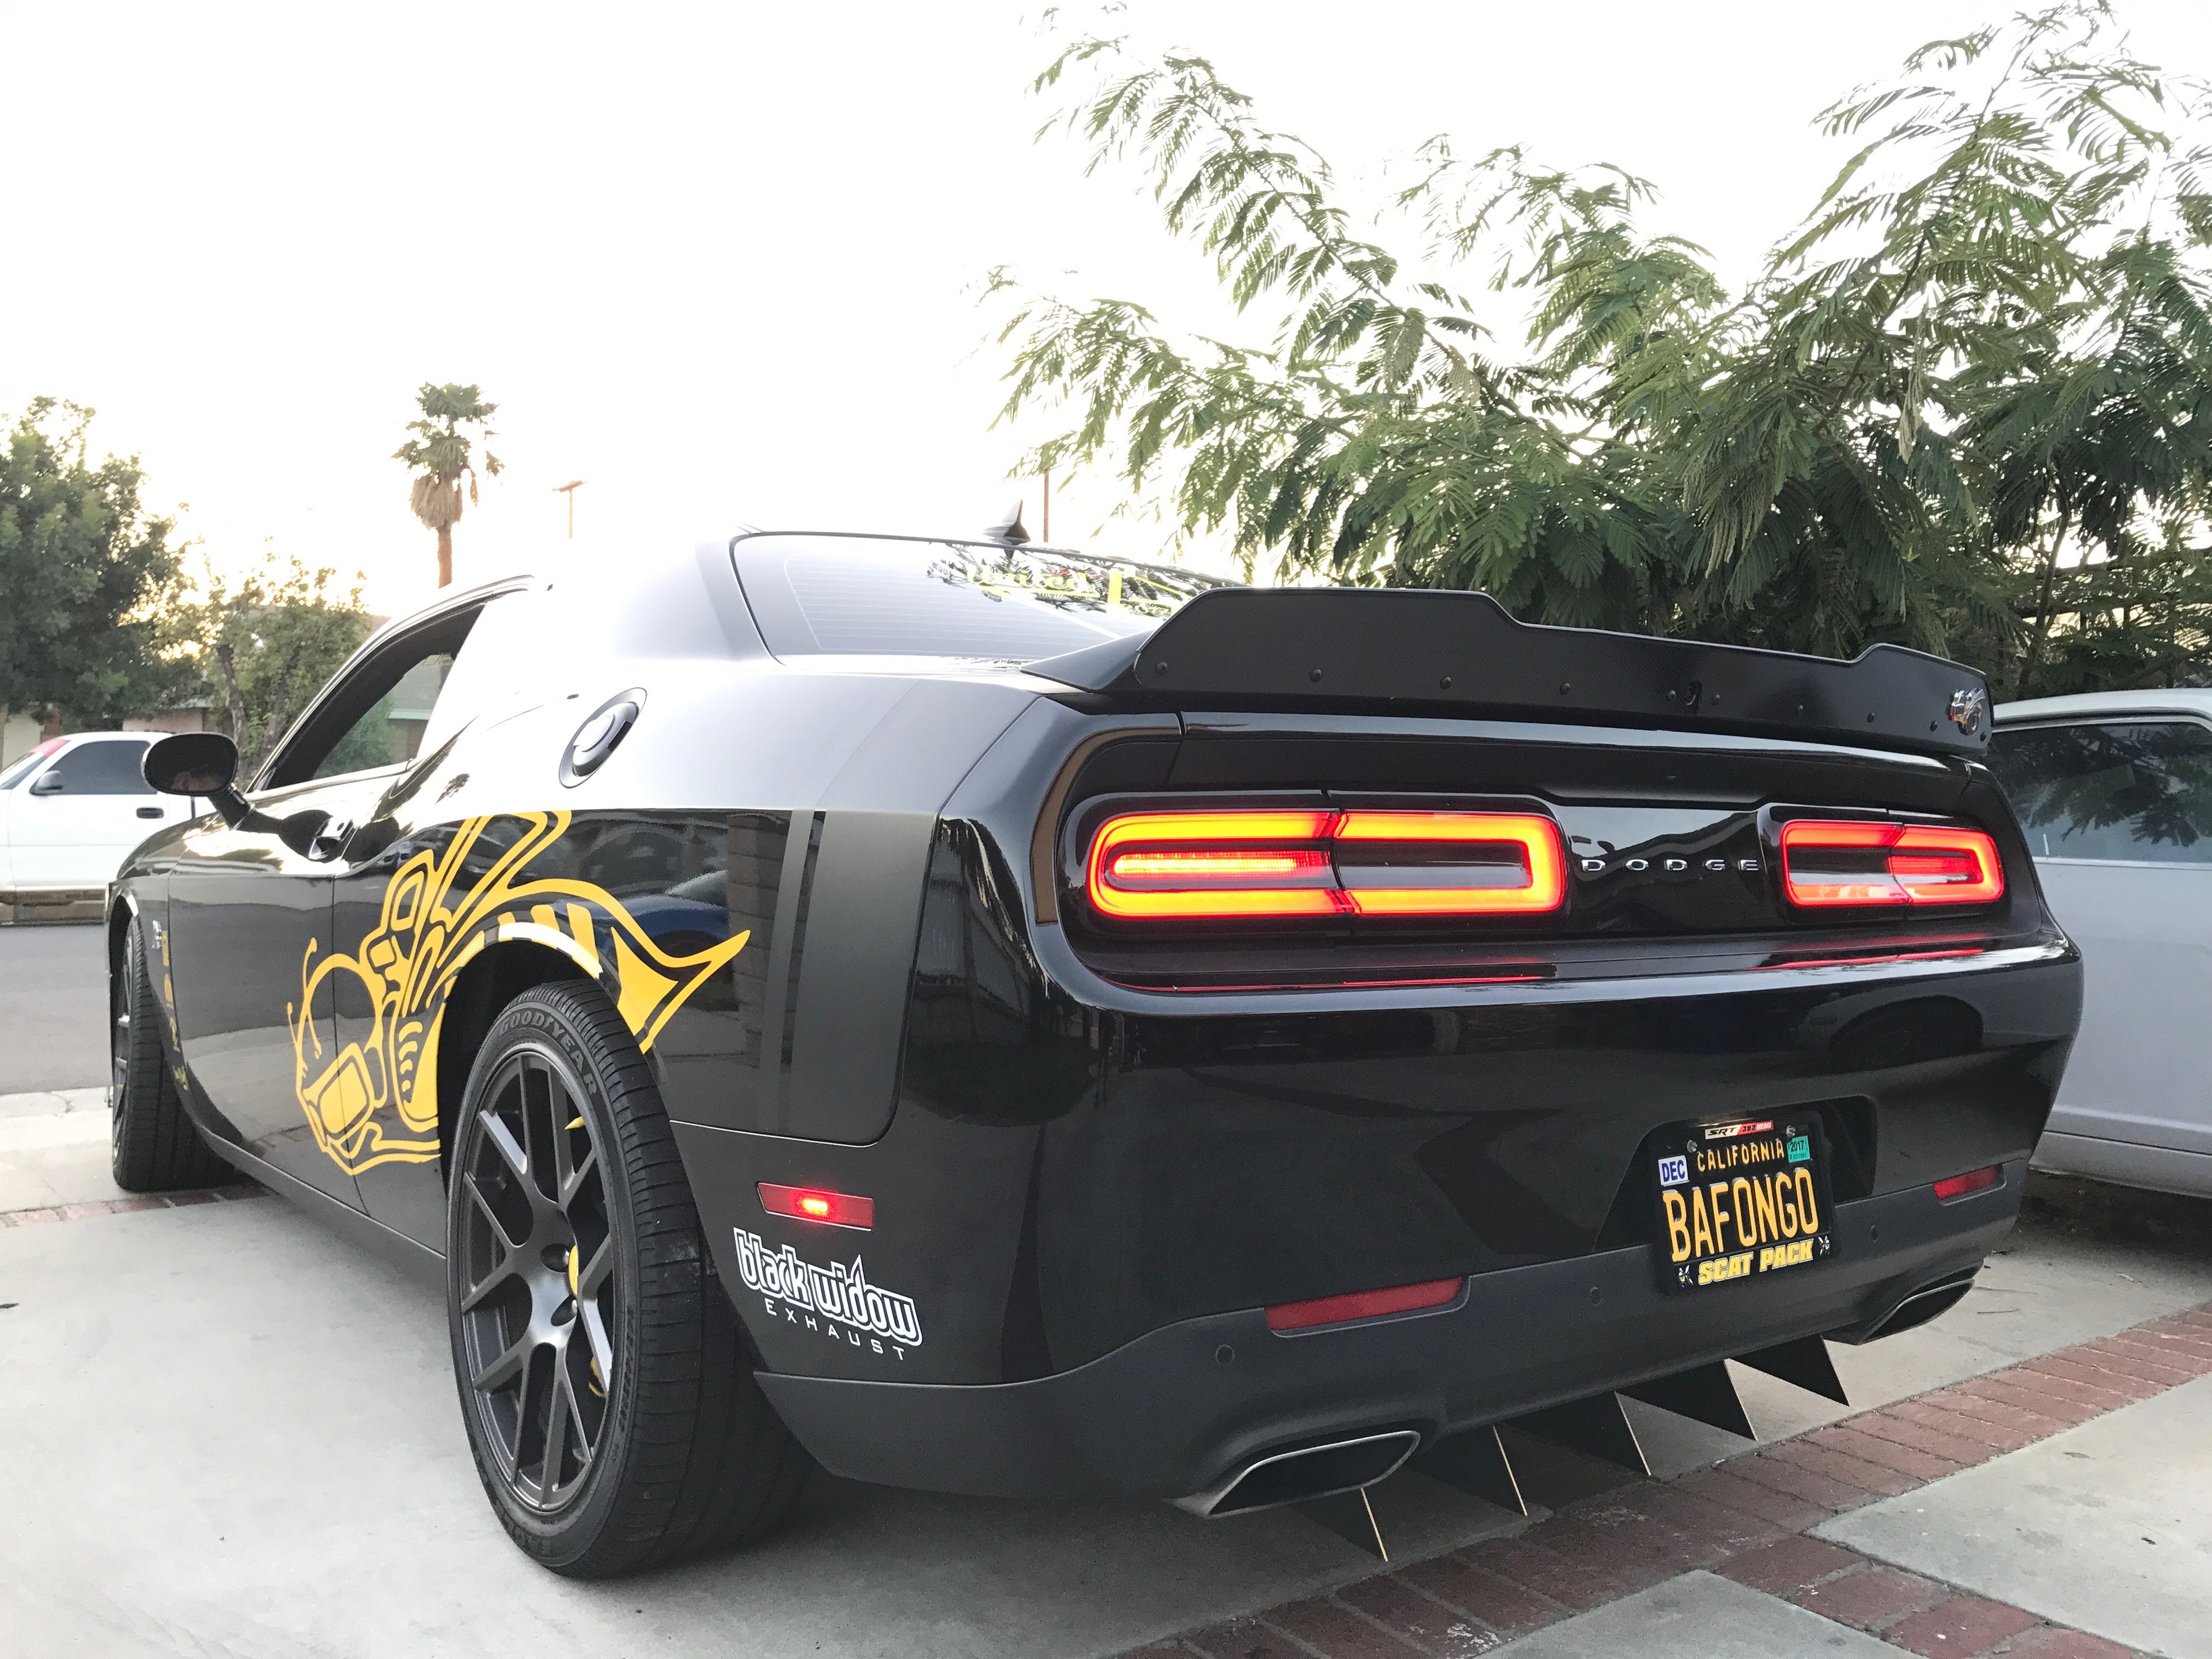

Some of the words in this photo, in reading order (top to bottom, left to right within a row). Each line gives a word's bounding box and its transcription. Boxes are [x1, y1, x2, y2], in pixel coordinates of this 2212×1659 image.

[1581, 859, 1759, 871] DODGE
[500, 1010, 597, 1094] GOODYEAR
[1708, 1126, 1737, 1136] SRT
[1742, 1124, 1756, 1132] 392
[1790, 1139, 1804, 1152] 2017
[1661, 1159, 1685, 1182] DEC
[1697, 1138, 1785, 1172] CALIFORNIA
[1662, 1167, 1819, 1262] BAFONGO
[1698, 1251, 1754, 1285] SCAT
[1759, 1238, 1815, 1272] PACK
[764, 1298, 904, 1360] EXHAUST
